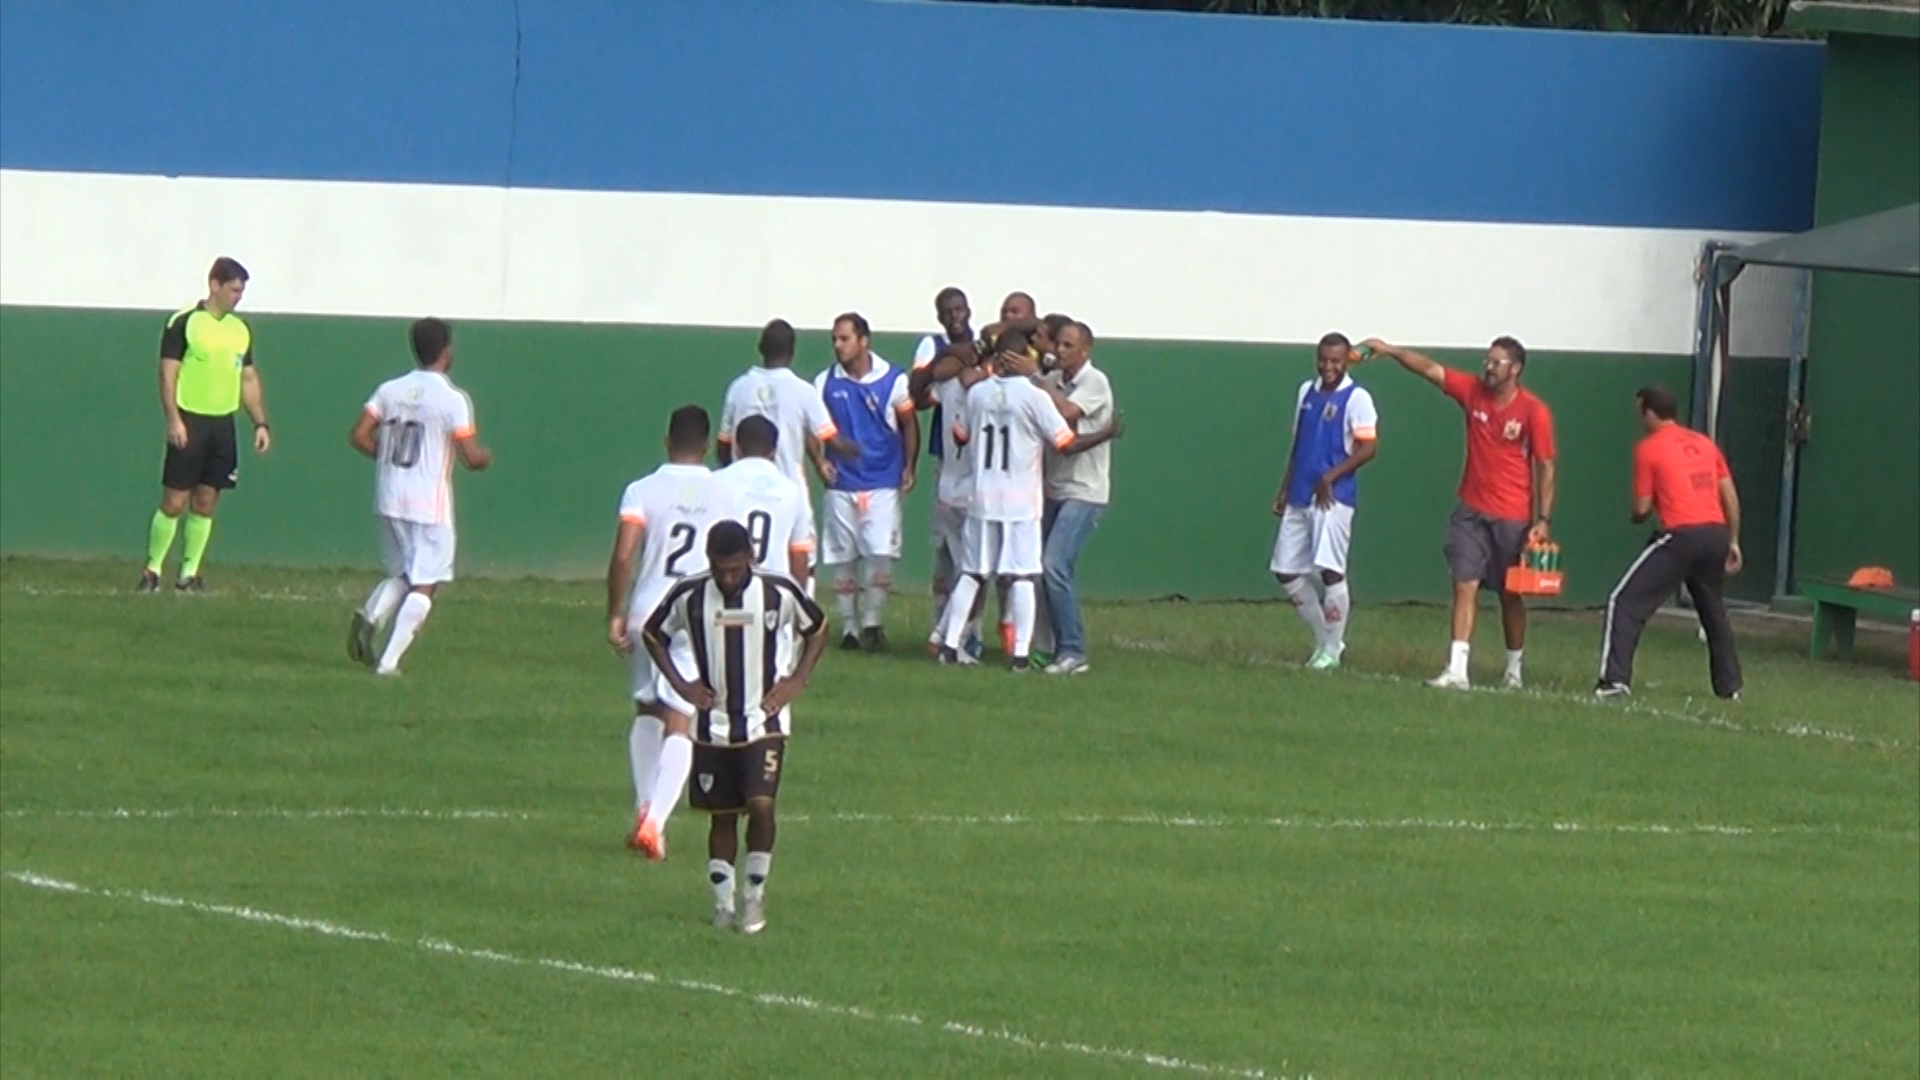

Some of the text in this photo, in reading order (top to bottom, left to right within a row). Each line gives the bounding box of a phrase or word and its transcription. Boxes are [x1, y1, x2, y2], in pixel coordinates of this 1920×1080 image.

[383, 416, 426, 469] 10
[981, 422, 1010, 471] 11
[665, 522, 697, 578] 2
[747, 509, 771, 565] 9
[764, 750, 778, 772] 5
